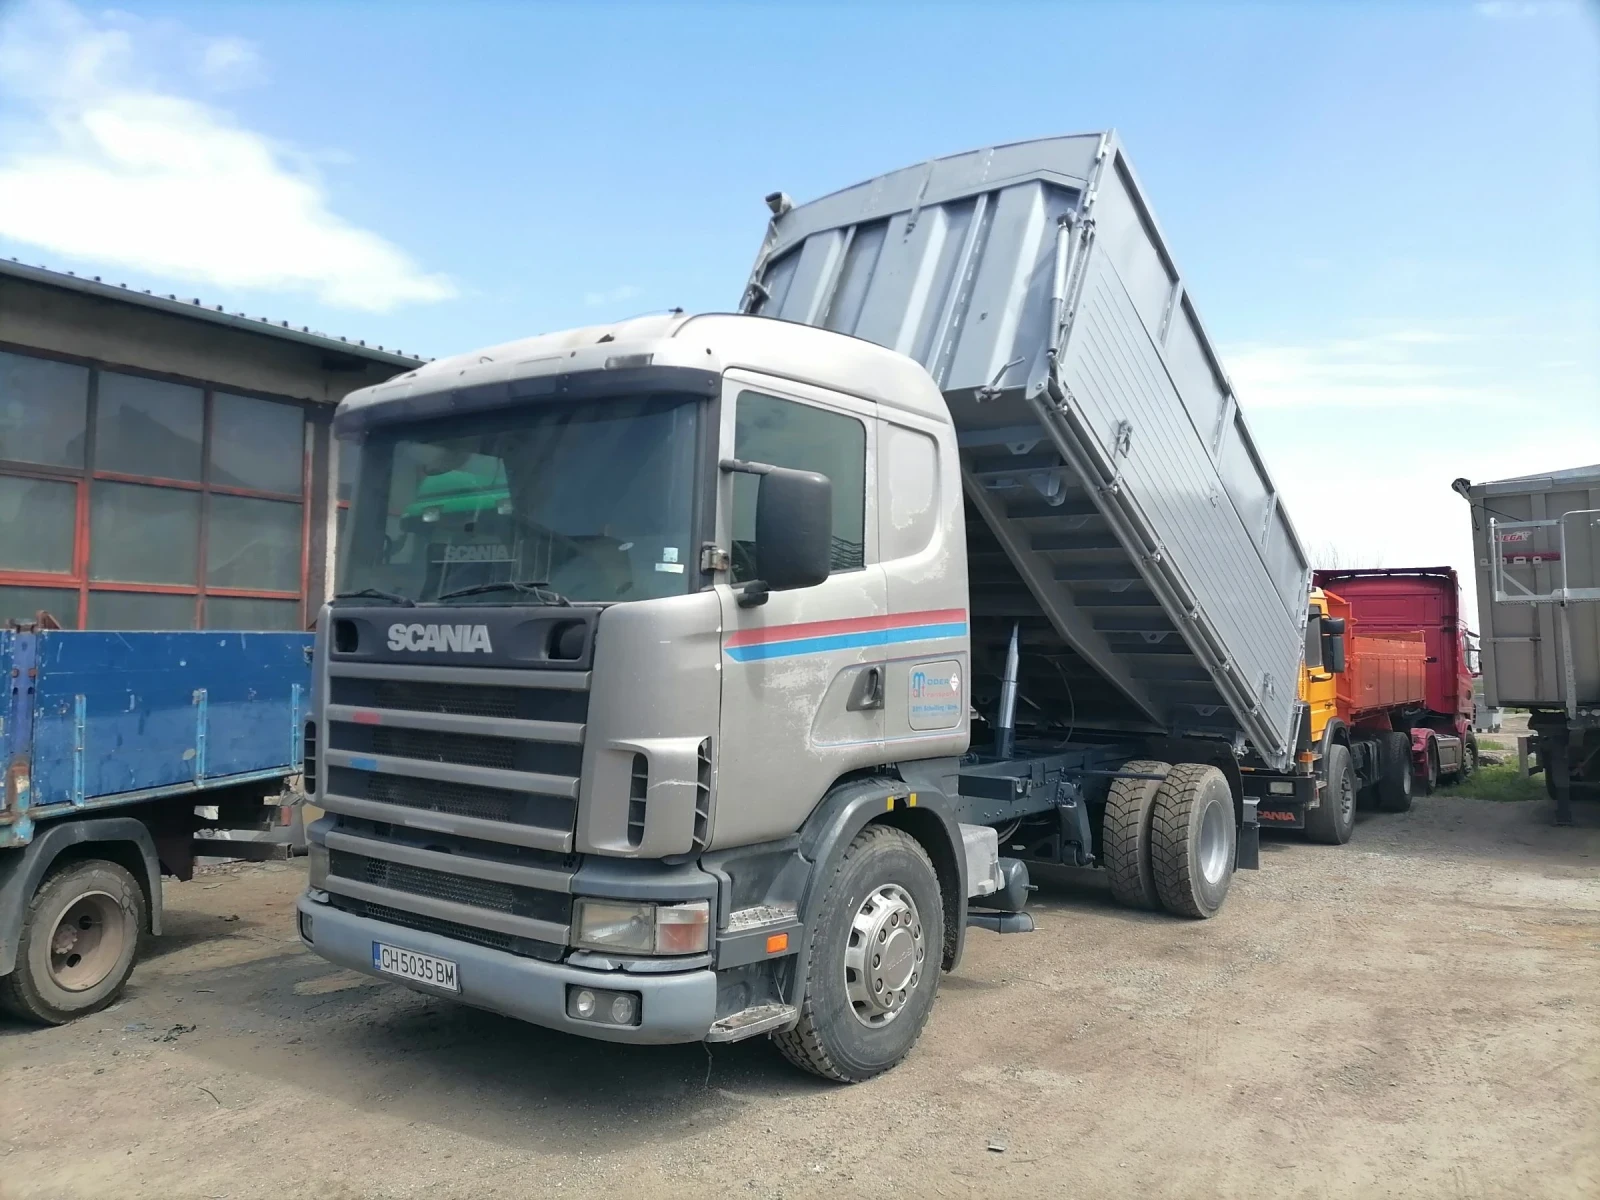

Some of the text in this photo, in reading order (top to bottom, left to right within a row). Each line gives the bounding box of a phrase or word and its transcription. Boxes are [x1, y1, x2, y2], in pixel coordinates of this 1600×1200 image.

[444, 544, 509, 560] SCANIA
[387, 623, 493, 653] SCANIA
[1257, 811, 1296, 821] CANIA
